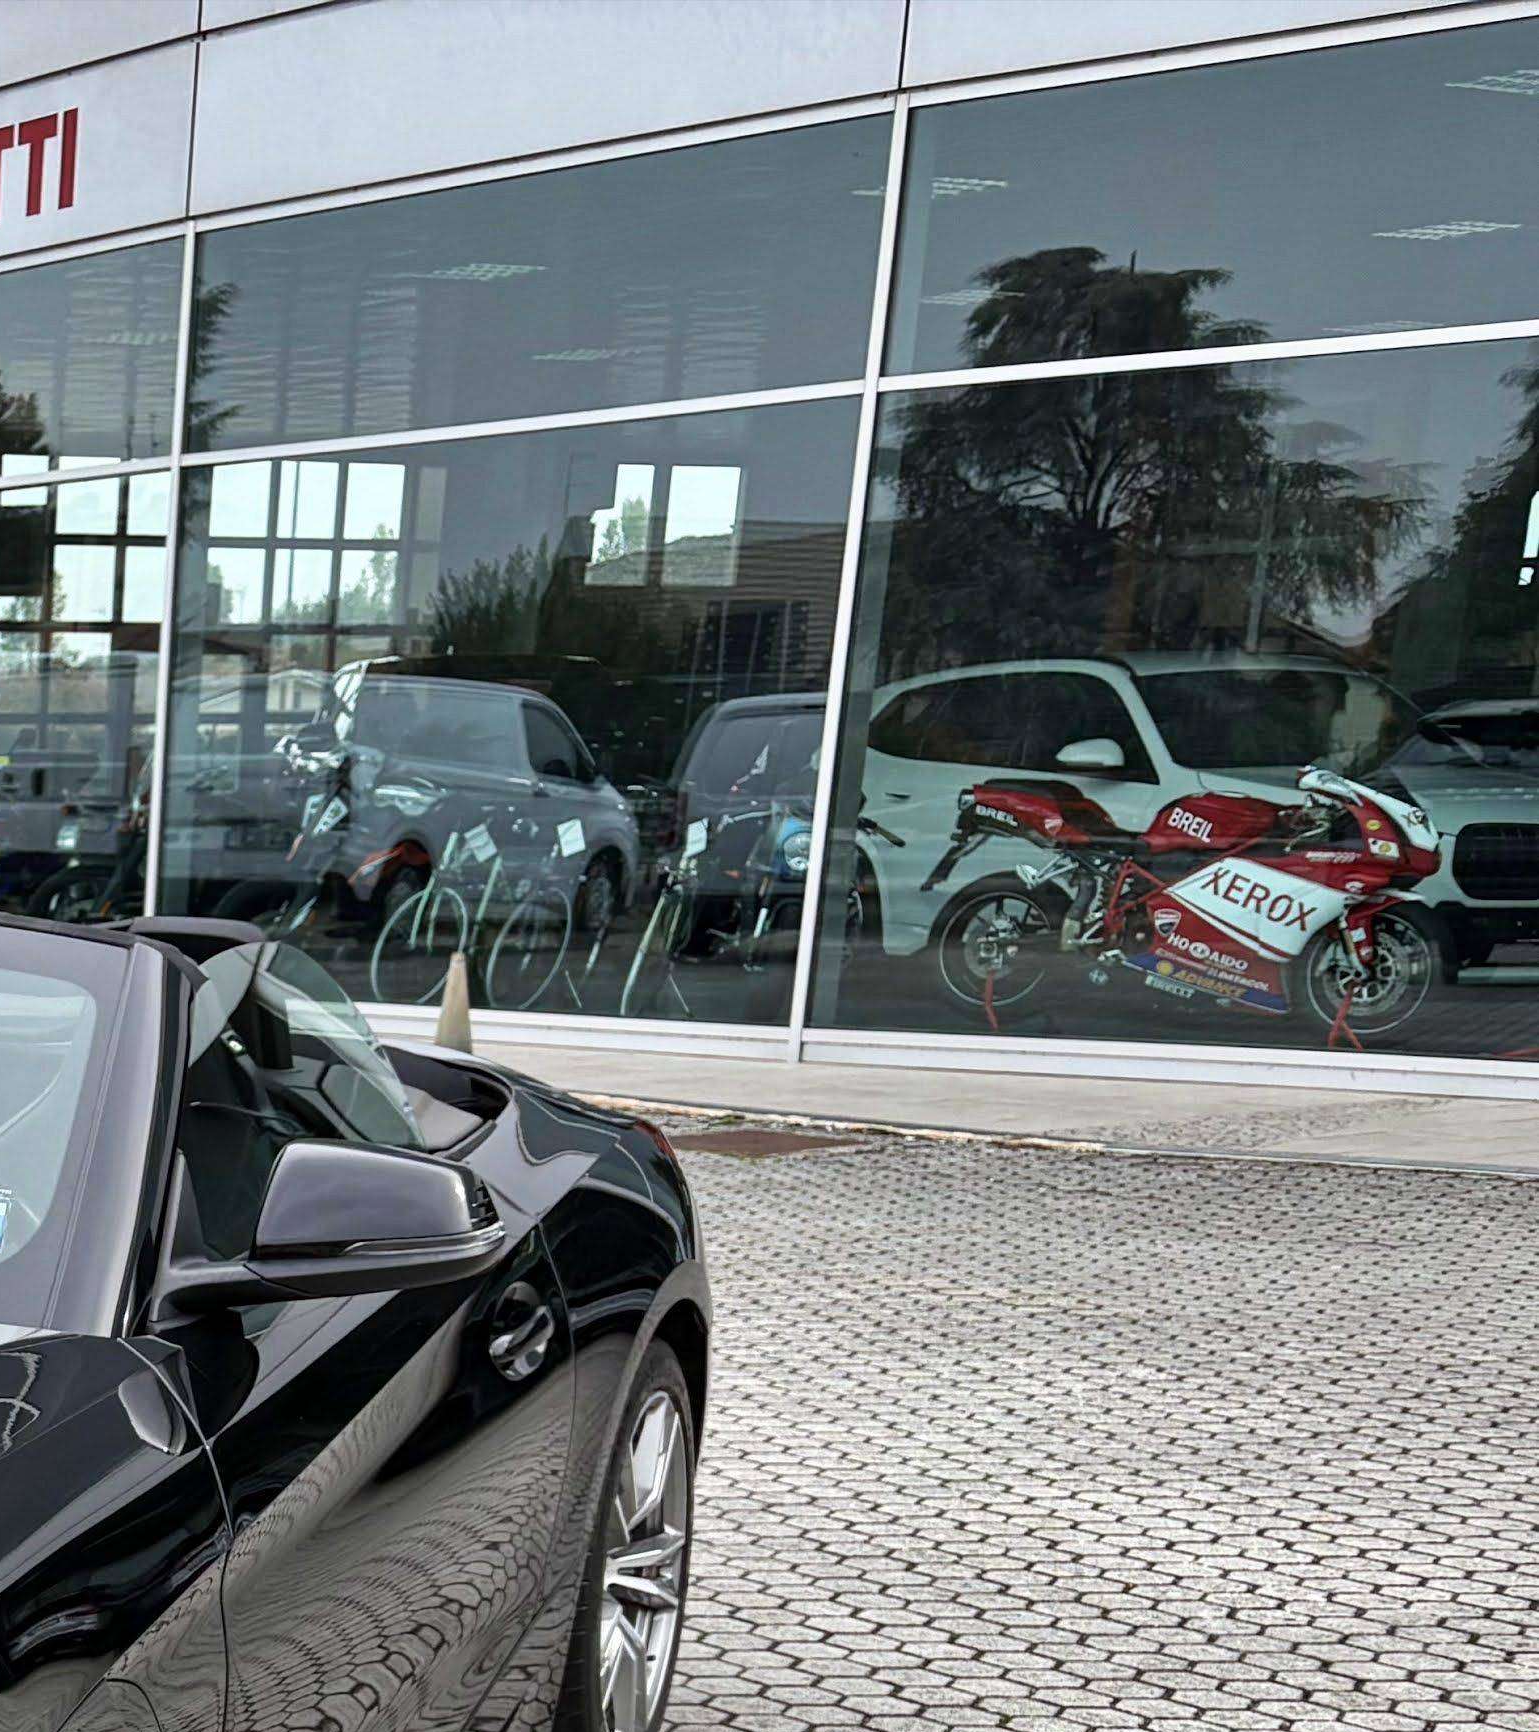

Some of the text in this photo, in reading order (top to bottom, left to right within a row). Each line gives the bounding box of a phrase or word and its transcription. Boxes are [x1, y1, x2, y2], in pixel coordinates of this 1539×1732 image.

[975, 804, 1019, 828] BREIL
[1167, 807, 1214, 842] BREIL
[1200, 867, 1317, 933] XEROX
